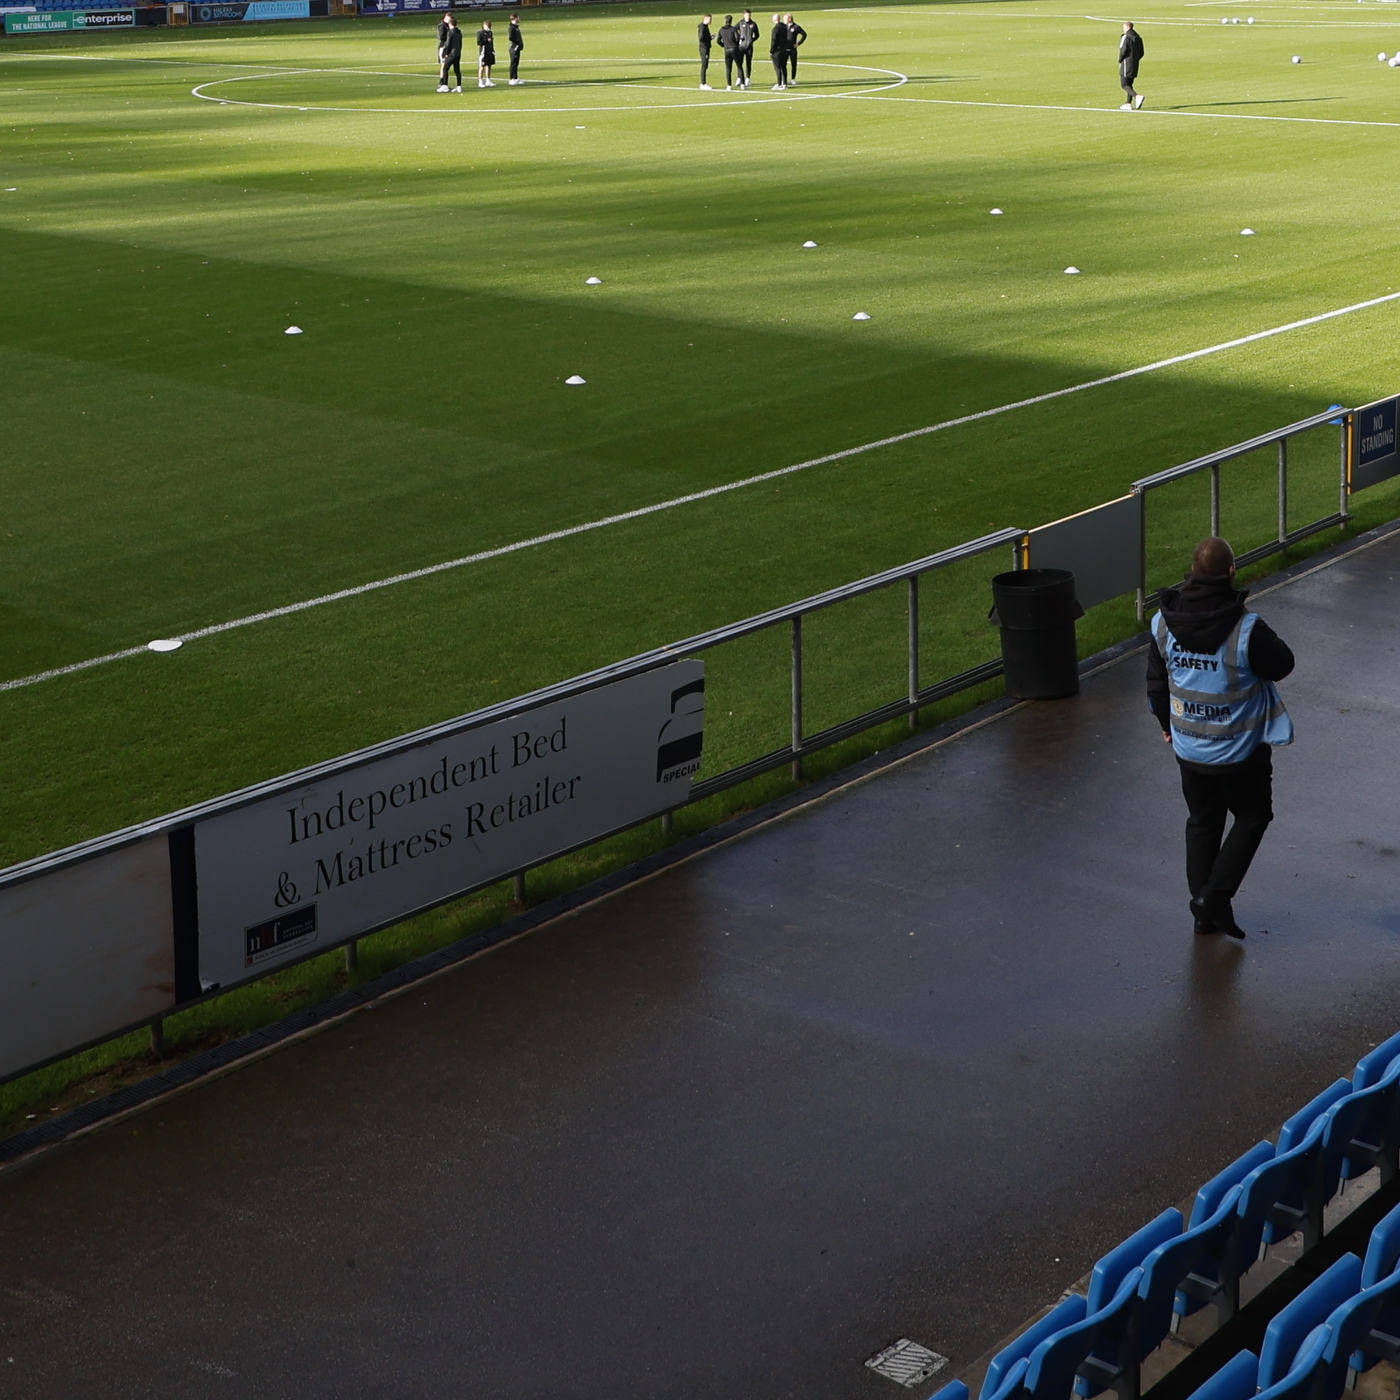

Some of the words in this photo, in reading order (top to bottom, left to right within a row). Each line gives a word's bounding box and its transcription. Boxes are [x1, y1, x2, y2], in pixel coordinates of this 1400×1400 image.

[74, 12, 132, 25] enterprise
[1373, 414, 1383, 432] NO
[1361, 428, 1394, 454] STANDING
[1173, 657, 1218, 672] SAFETY
[1184, 701, 1232, 719] MEDIA
[286, 743, 501, 846] Independent
[511, 717, 568, 769] Bed
[272, 871, 302, 908] &
[312, 821, 453, 896] Mattress
[464, 772, 583, 840] Retailer
